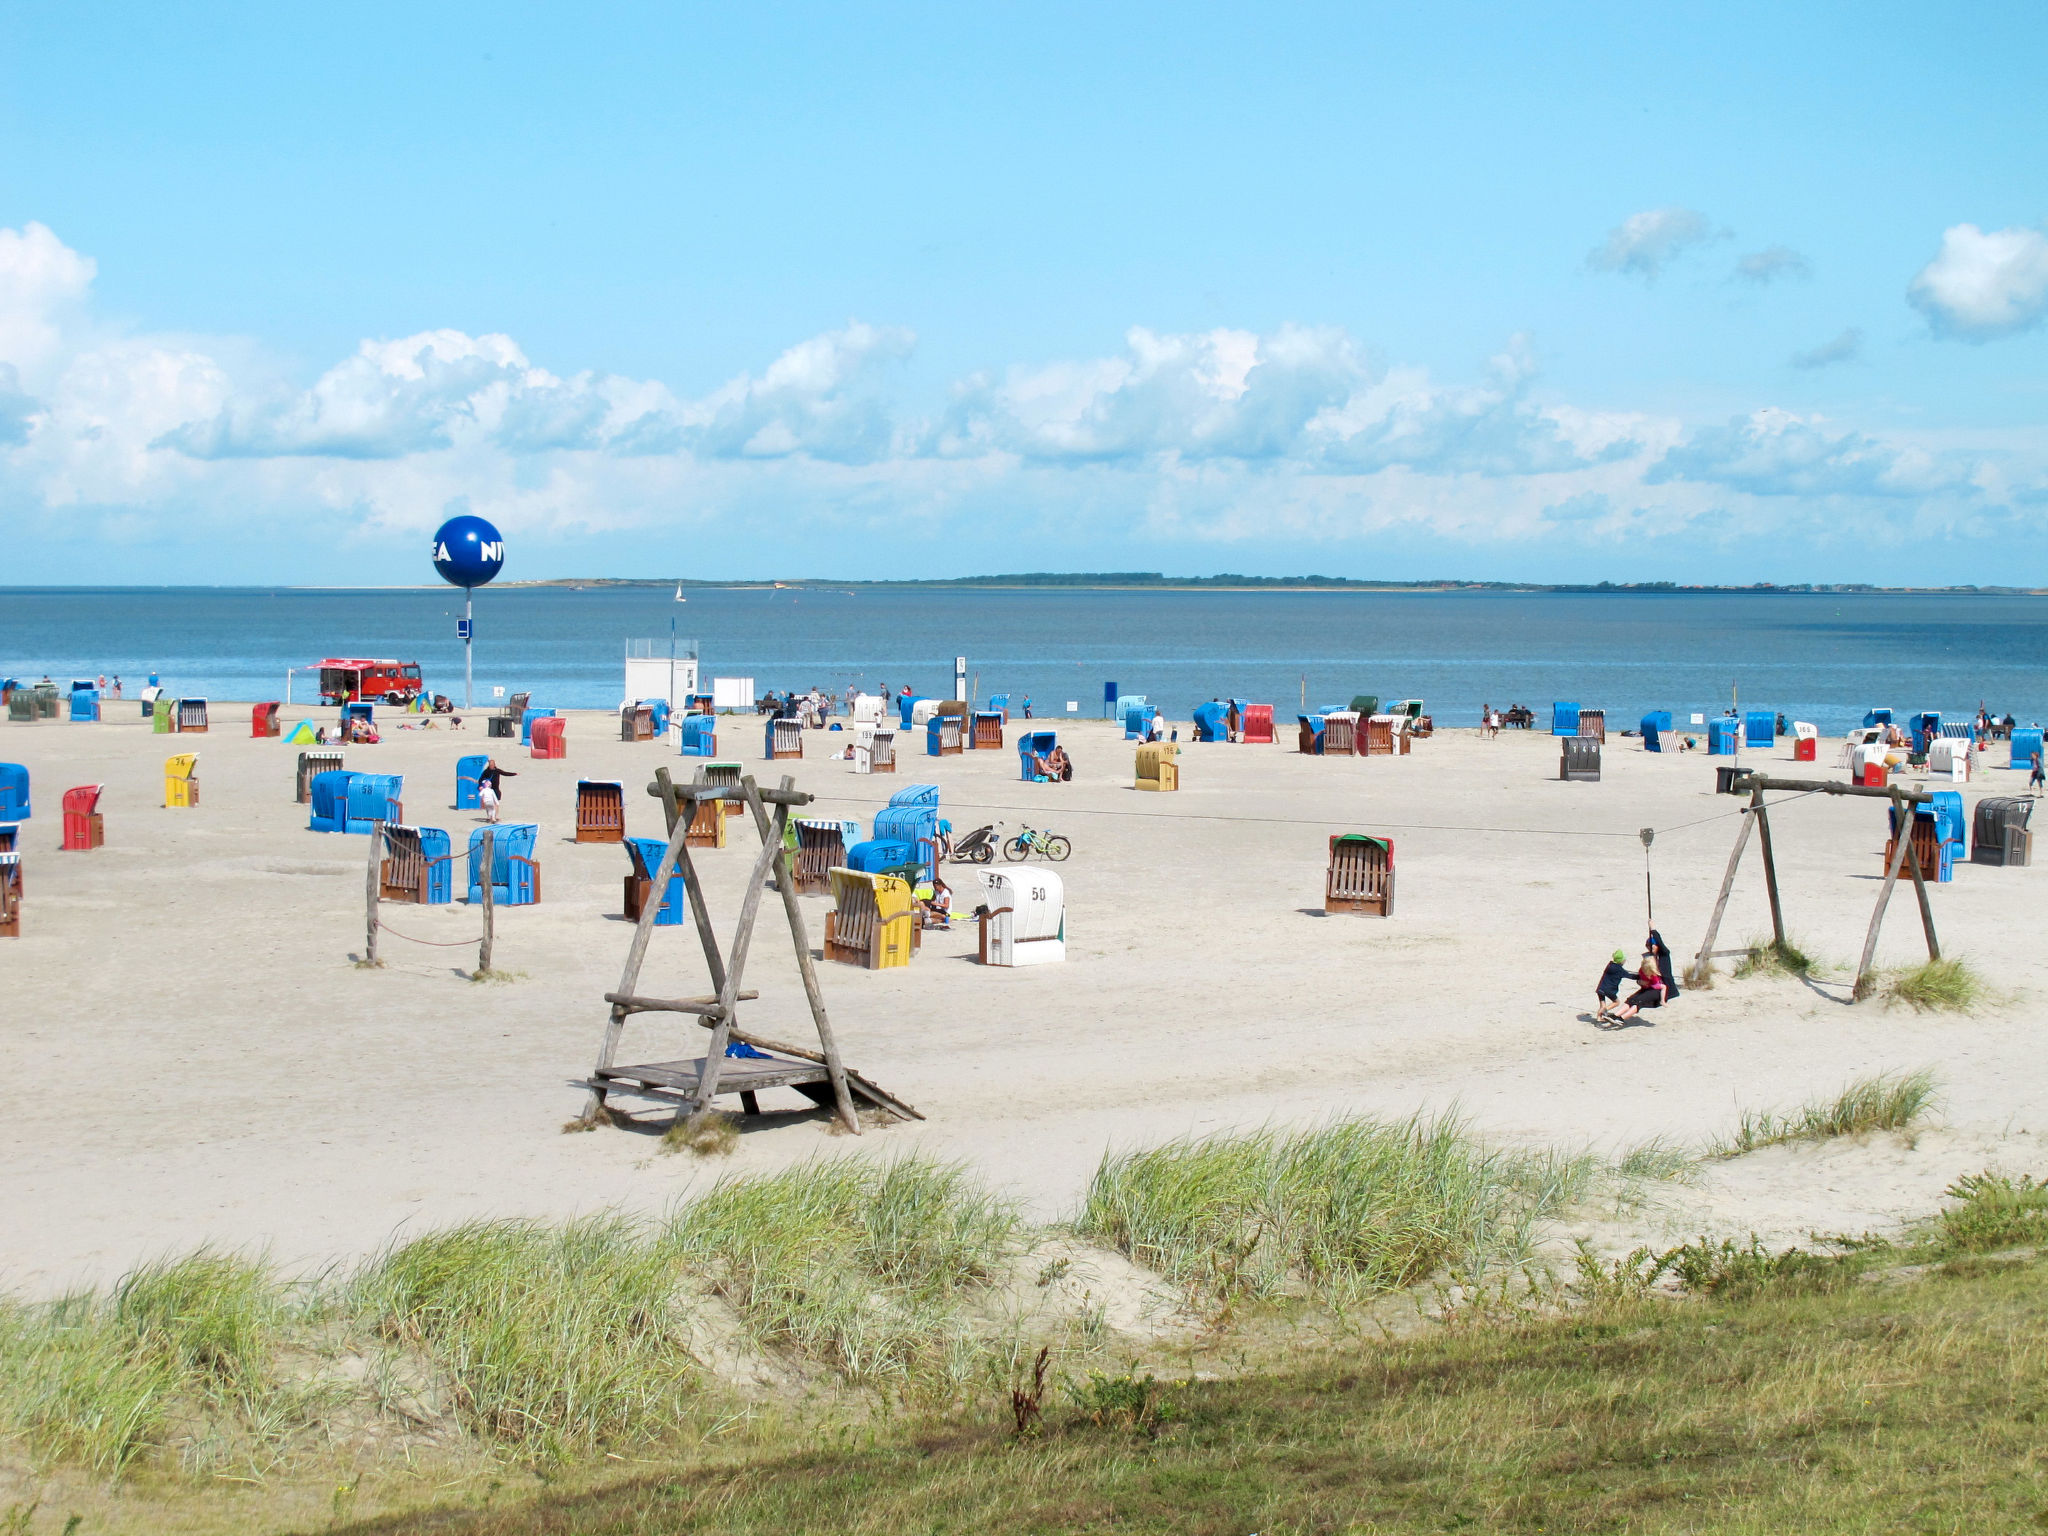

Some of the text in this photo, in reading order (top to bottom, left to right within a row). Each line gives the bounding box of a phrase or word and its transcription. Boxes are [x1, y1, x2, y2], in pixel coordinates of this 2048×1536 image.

[2018, 802, 2029, 813] 12
[988, 875, 1003, 890] 50
[1032, 887, 1046, 901] 50
